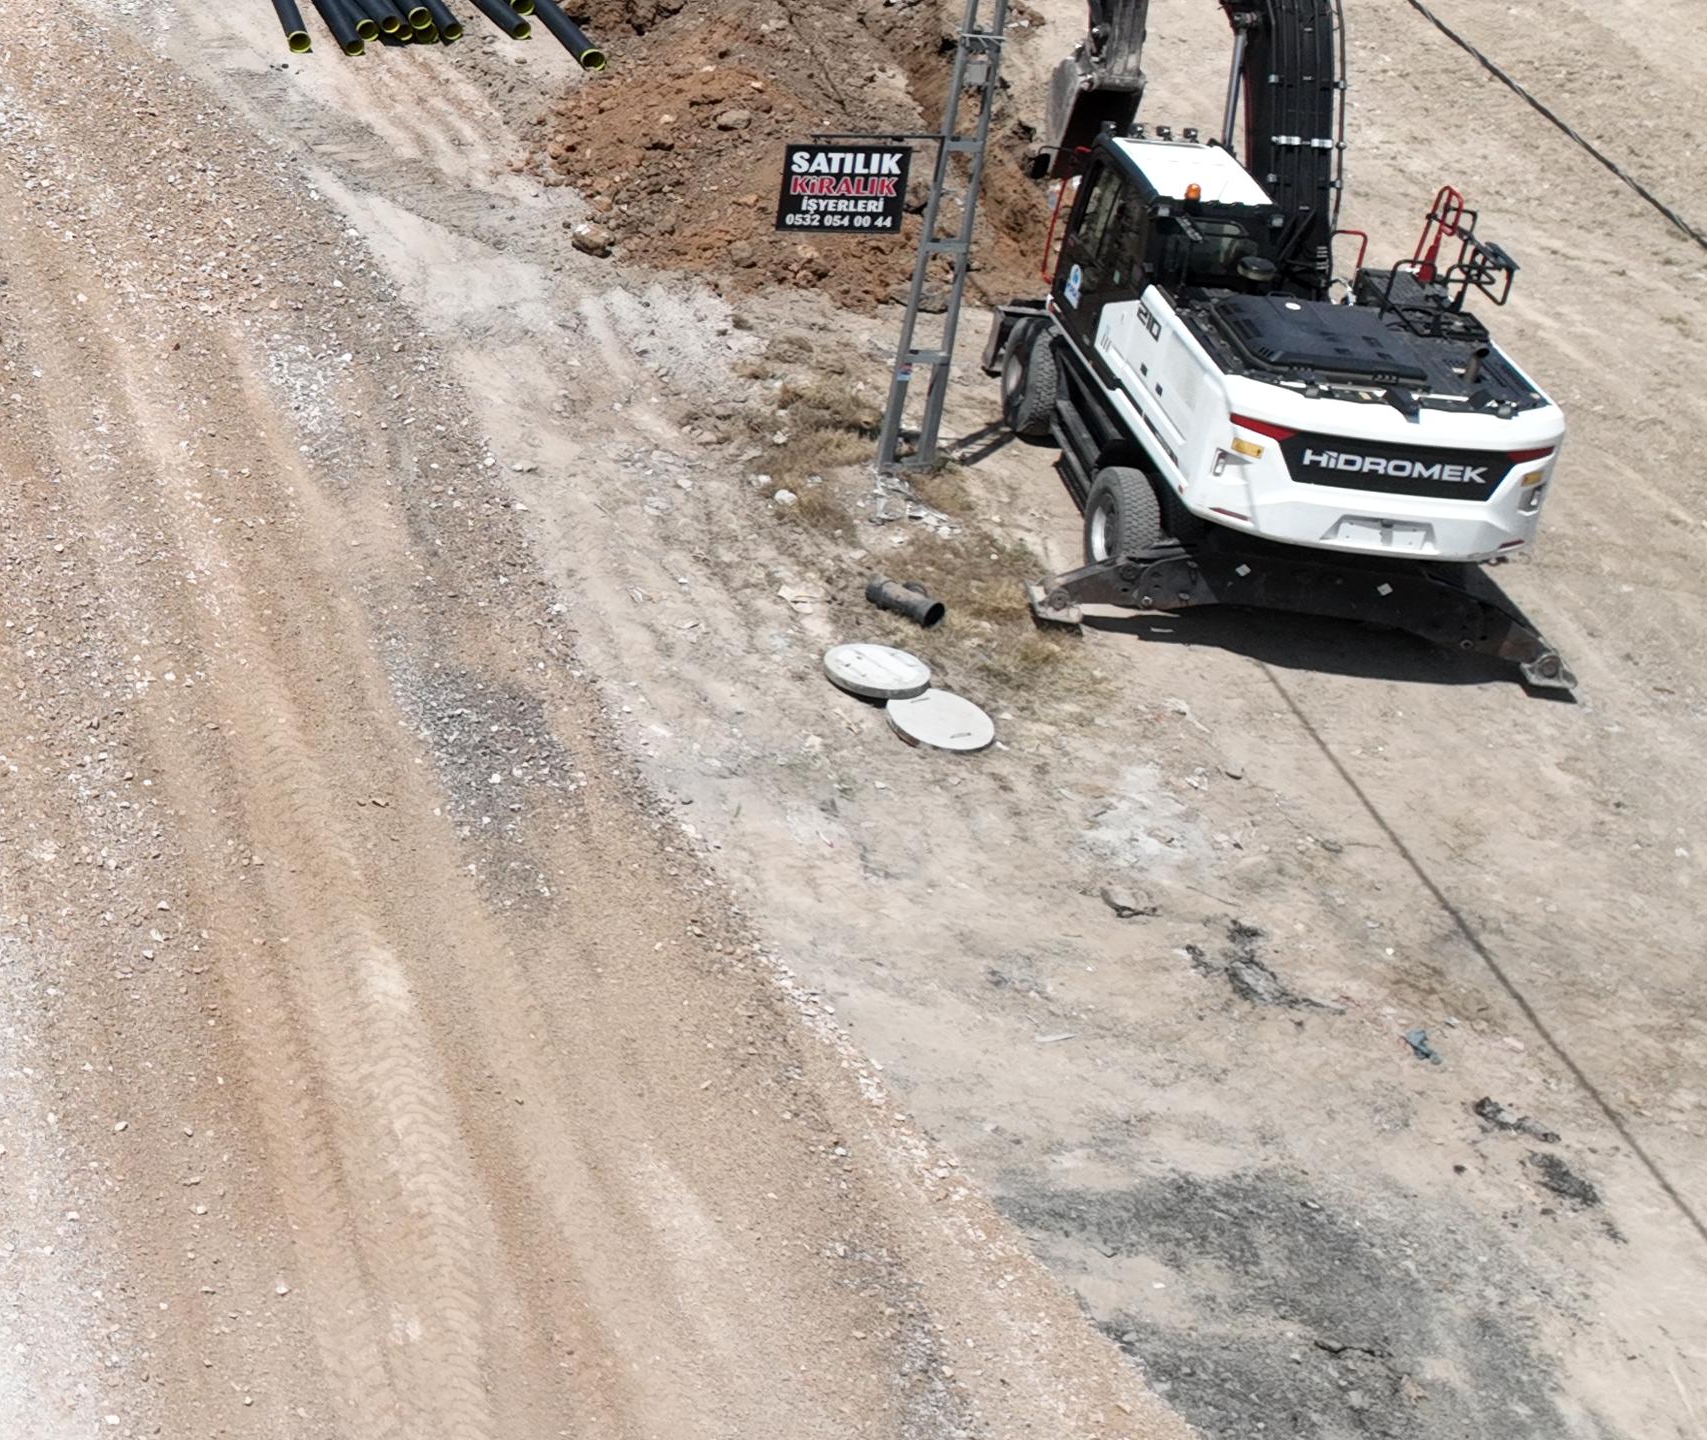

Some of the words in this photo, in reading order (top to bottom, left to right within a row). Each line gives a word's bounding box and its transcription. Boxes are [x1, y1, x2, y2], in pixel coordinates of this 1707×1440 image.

[791, 151, 903, 174] SATILIK
[801, 196, 884, 214] İŞYERLERİ
[785, 213, 821, 226] 0532
[823, 214, 850, 227] 054
[853, 215, 871, 227] 00
[873, 216, 893, 227] 44
[1136, 302, 1162, 342] 210
